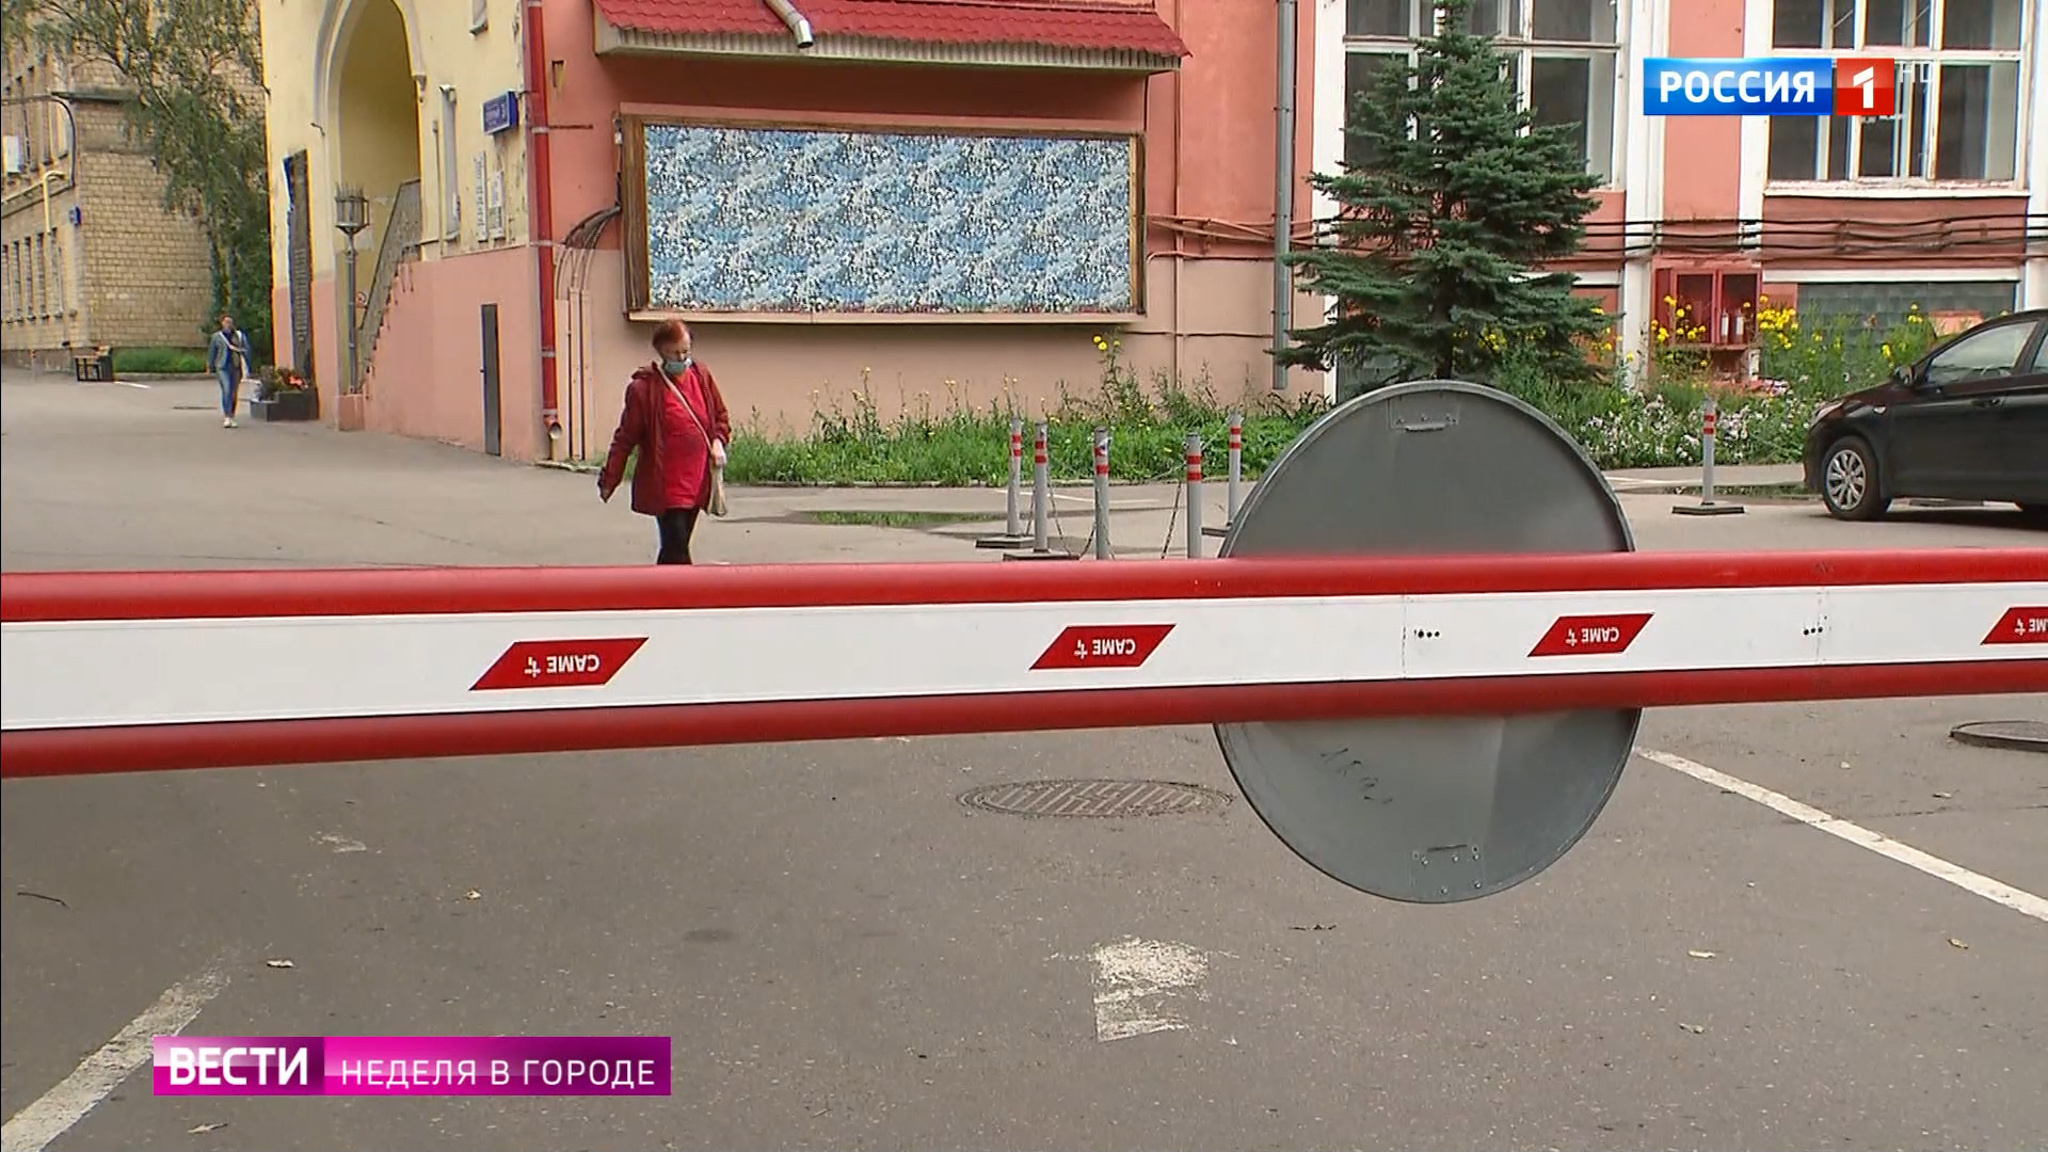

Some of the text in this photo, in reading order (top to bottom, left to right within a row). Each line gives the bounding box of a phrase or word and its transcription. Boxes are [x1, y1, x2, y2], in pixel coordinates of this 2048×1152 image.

[1581, 627, 1619, 643] CAME
[1092, 638, 1136, 655] CAME
[546, 654, 600, 673] CAME
